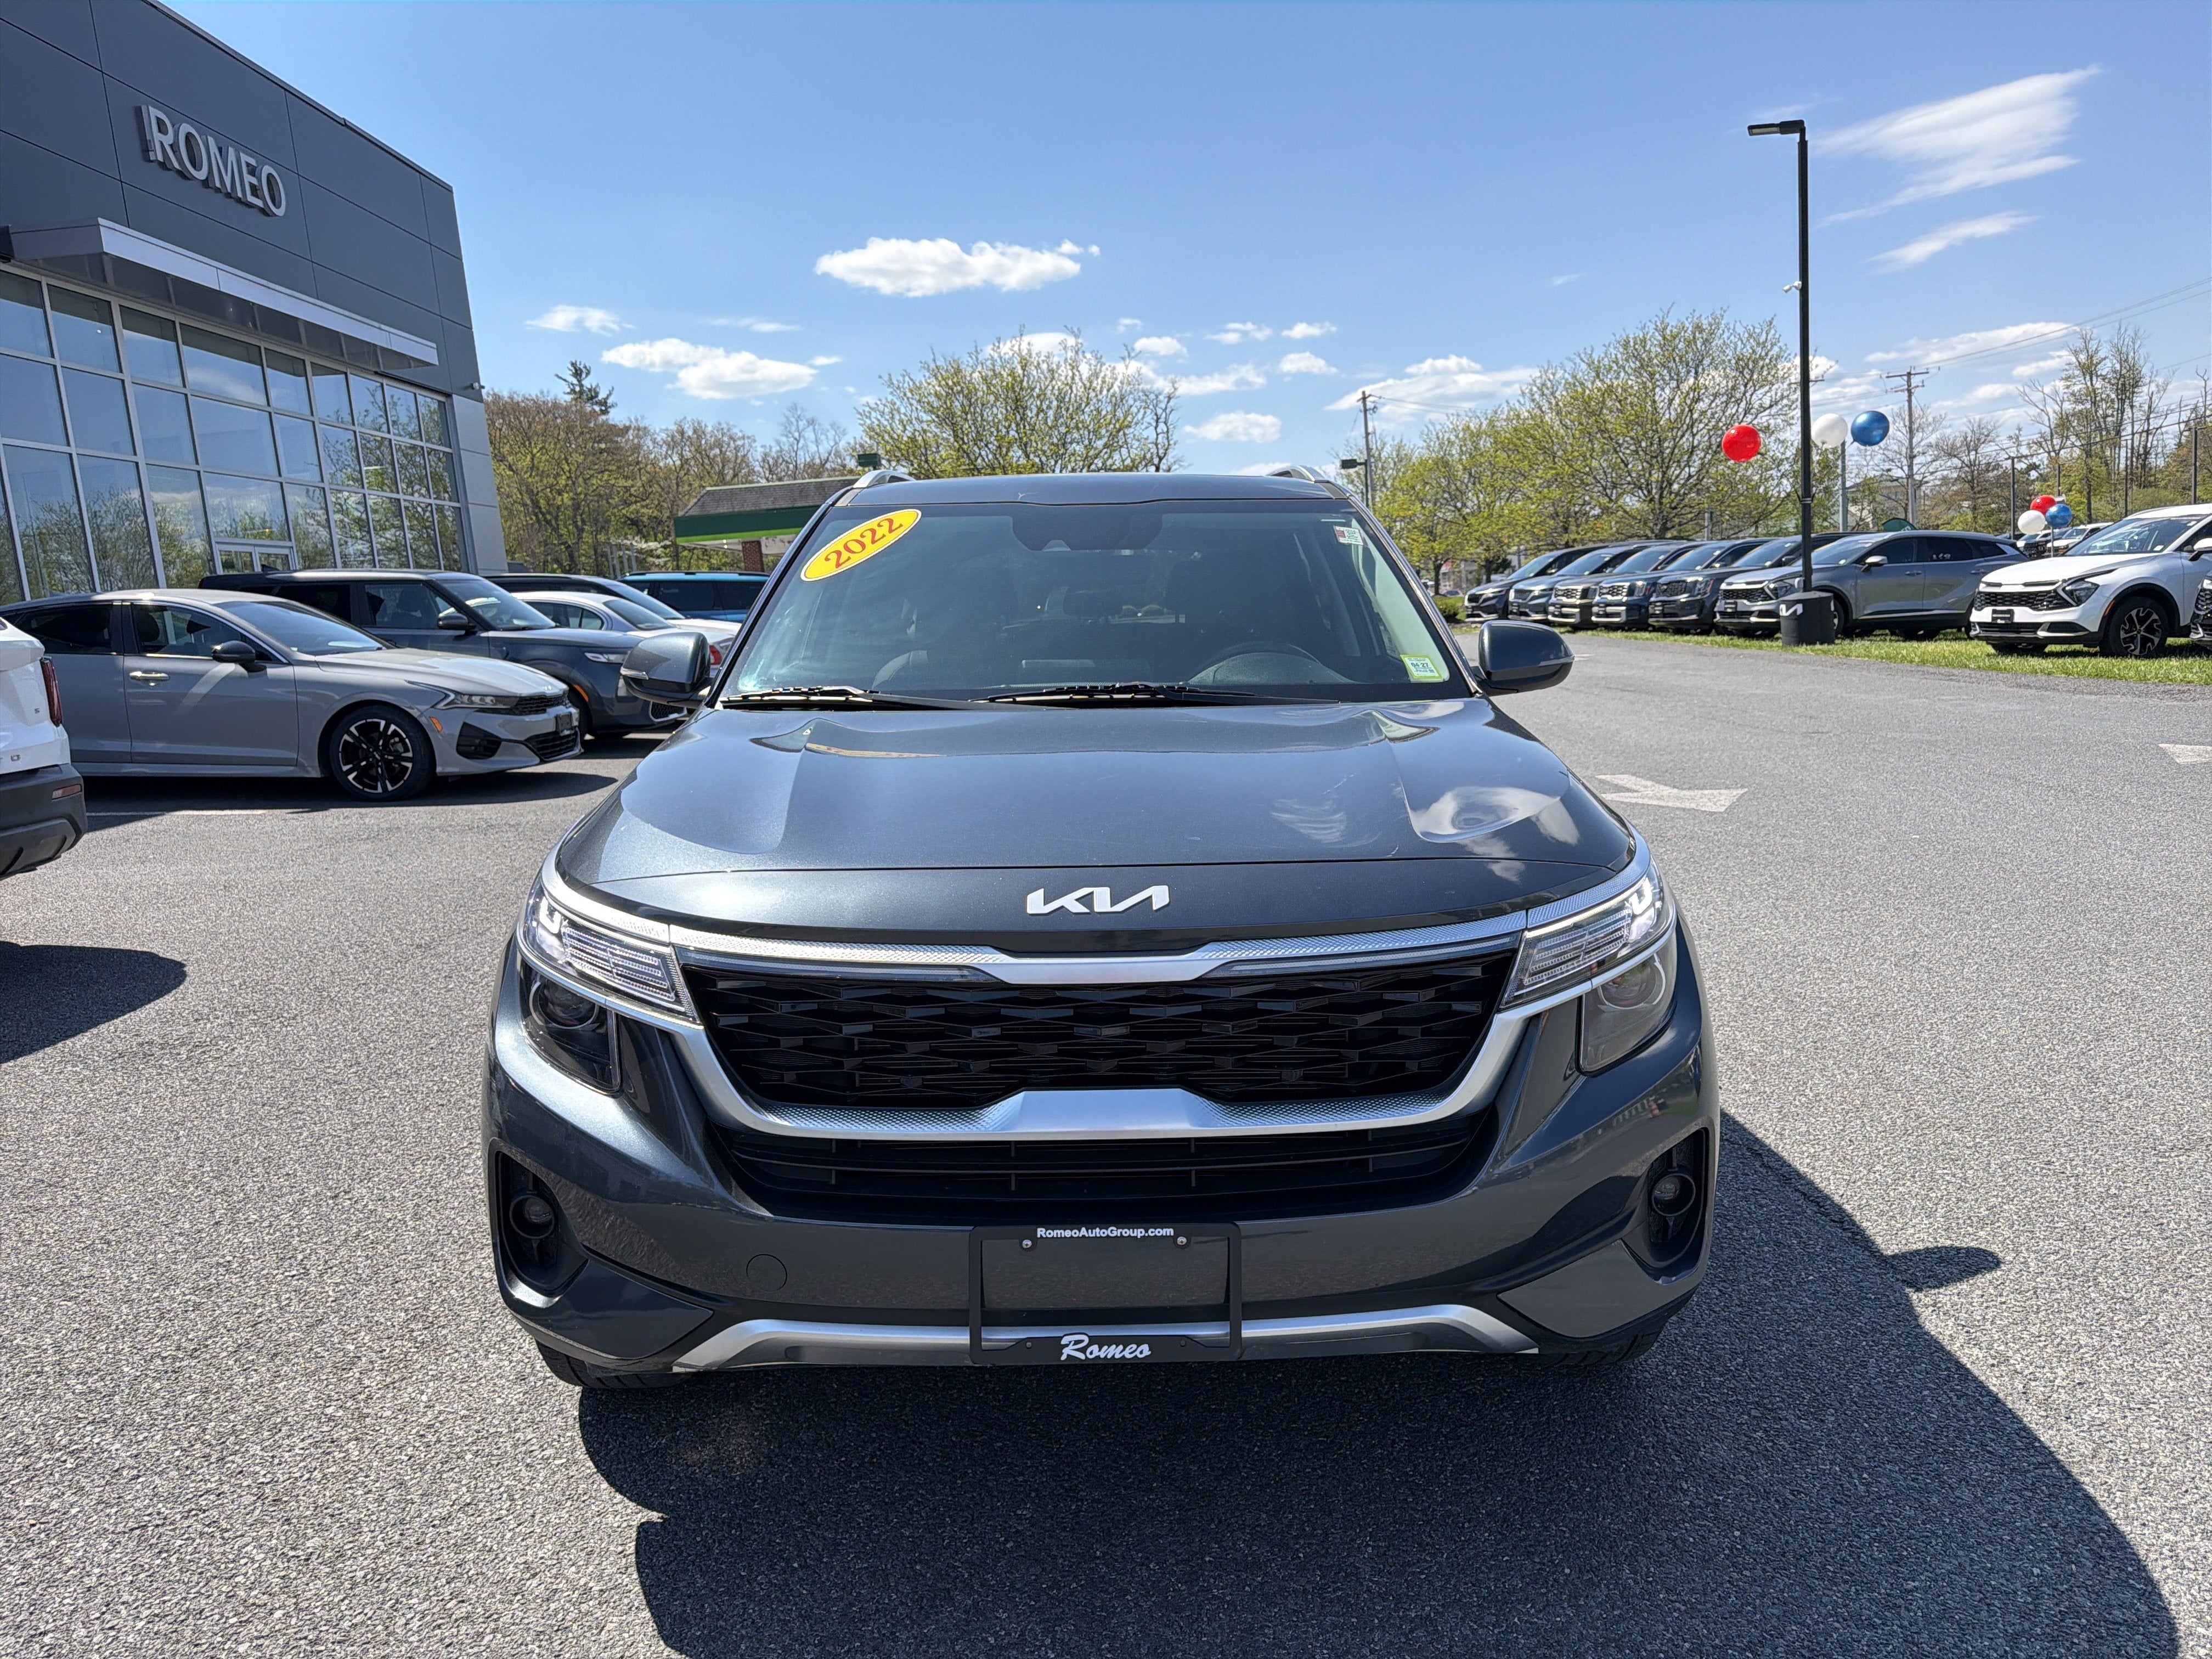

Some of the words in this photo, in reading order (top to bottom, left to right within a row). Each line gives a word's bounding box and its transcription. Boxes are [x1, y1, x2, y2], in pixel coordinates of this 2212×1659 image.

[143, 105, 286, 217] ROMEO
[824, 517, 904, 569] 2022
[1026, 885, 1170, 914] KIA
[1036, 1226, 1174, 1239] RomeoAutoGroup.com
[1060, 1334, 1152, 1361] Romeo
